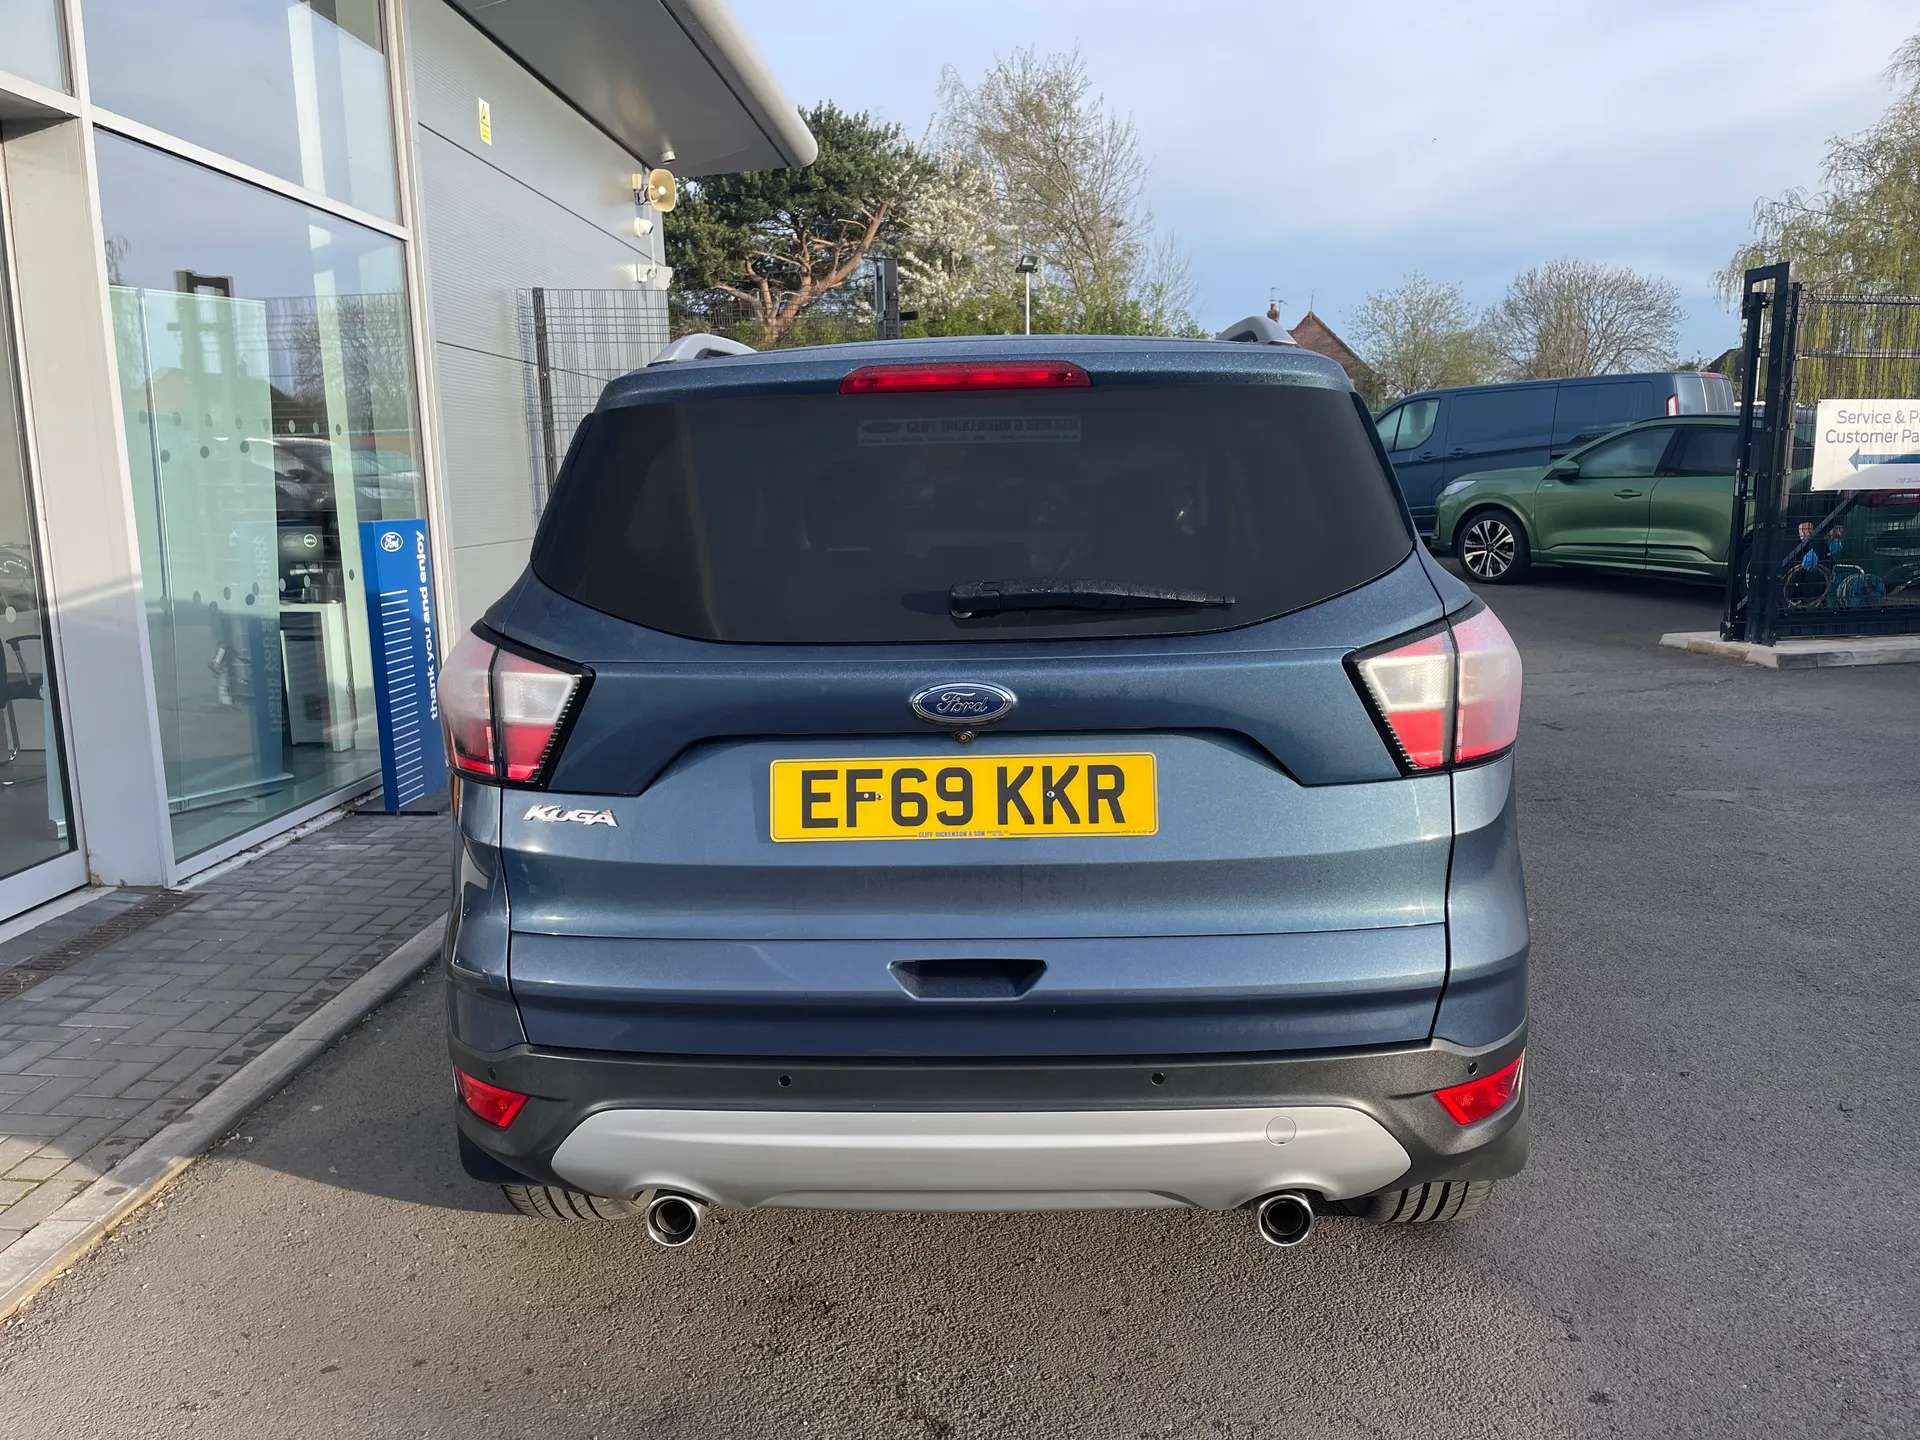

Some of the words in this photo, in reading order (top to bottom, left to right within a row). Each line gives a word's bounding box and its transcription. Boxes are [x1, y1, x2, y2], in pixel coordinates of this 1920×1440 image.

[1837, 409, 1891, 424] Service
[1895, 409, 1905, 424] &
[1825, 429, 1898, 444] Customer
[415, 530, 427, 584] enjoy
[419, 585, 431, 624] and
[425, 627, 436, 662] you
[427, 662, 438, 721] thank
[936, 691, 989, 713] Ford
[801, 767, 974, 829] EF69
[996, 764, 1127, 826] KKR
[523, 804, 619, 828] KUGA
